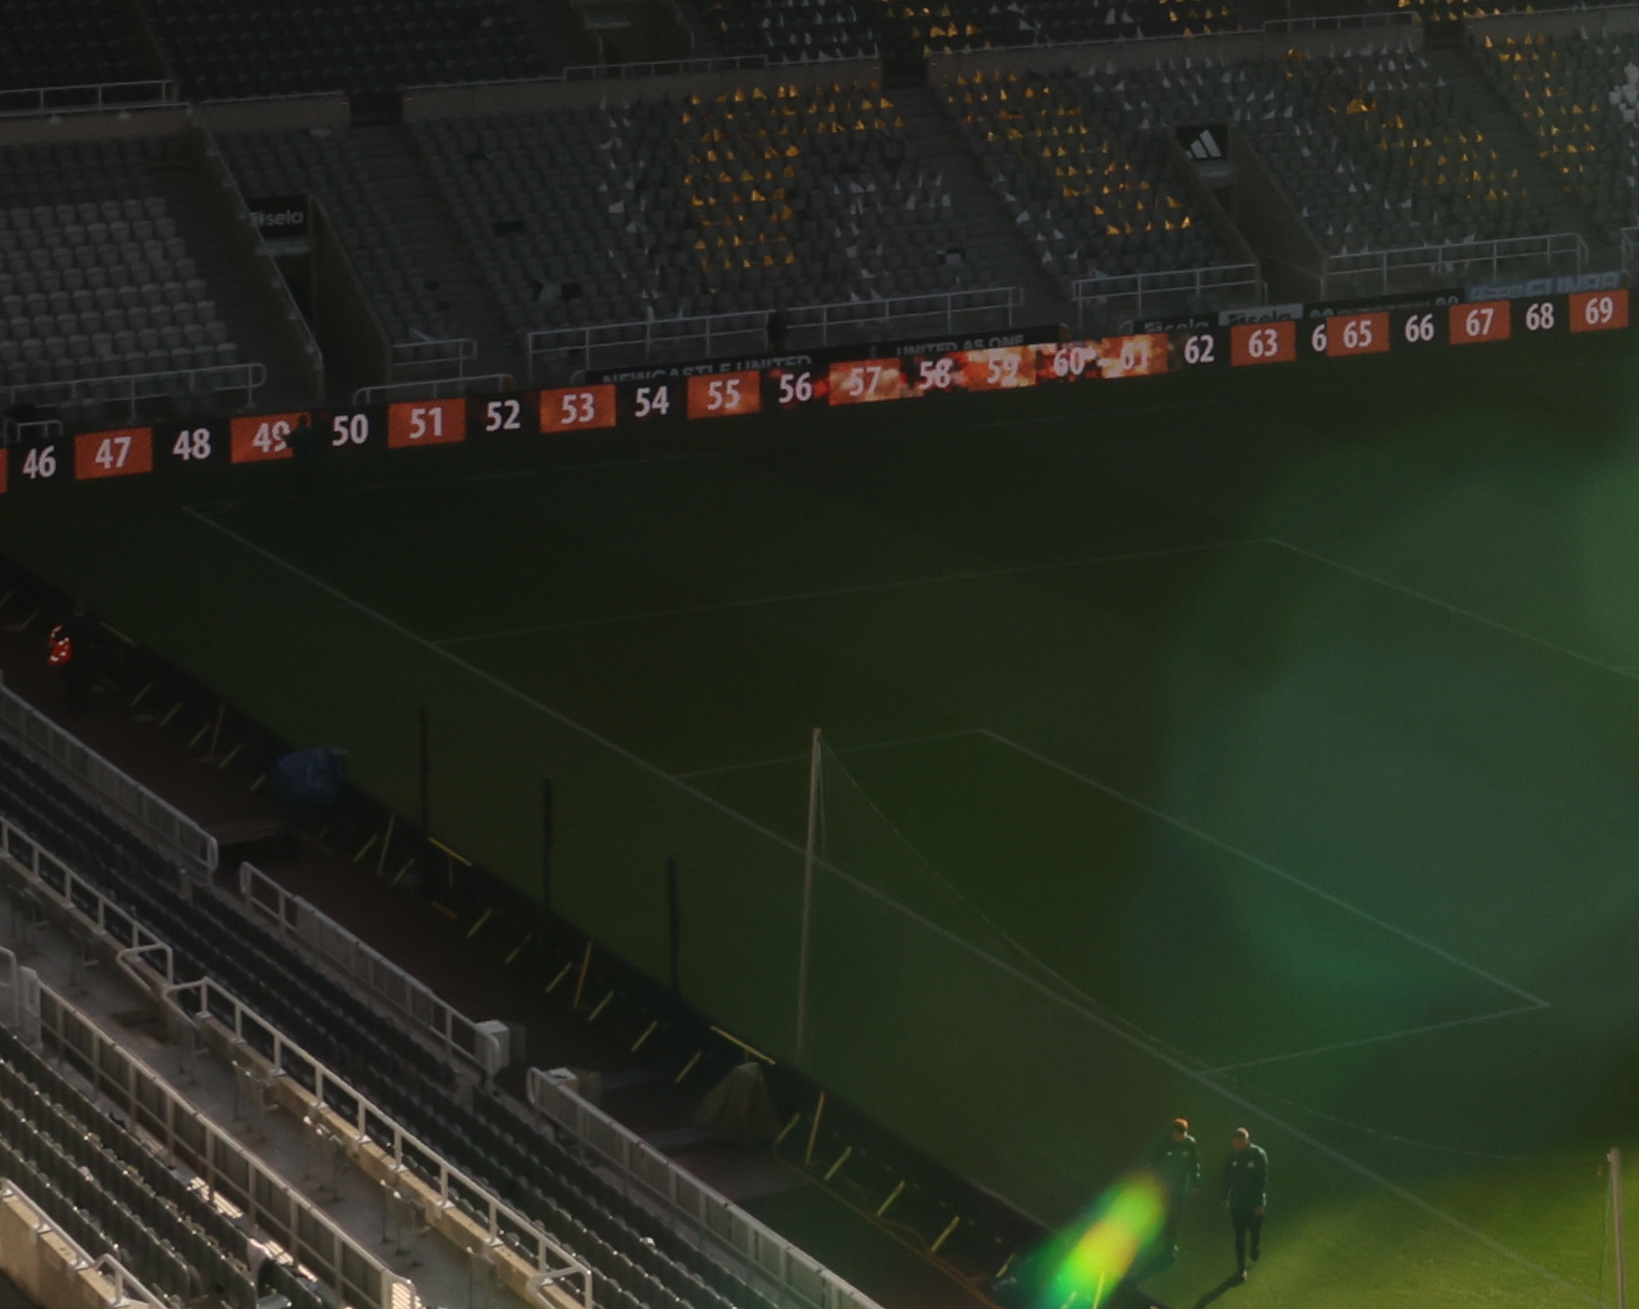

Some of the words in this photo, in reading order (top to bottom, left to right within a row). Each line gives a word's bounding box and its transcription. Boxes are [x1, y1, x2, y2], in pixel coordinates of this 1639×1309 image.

[265, 209, 303, 226] sela
[23, 446, 56, 478] 46
[95, 437, 131, 468] 47
[174, 428, 210, 460] 48
[253, 421, 290, 452] 49
[333, 414, 368, 446] 50
[410, 407, 441, 438] 51
[486, 400, 520, 431] 52
[562, 393, 594, 423] 53
[636, 386, 669, 417] 54
[708, 379, 740, 410] 55
[779, 372, 812, 403] 56
[849, 367, 881, 396] 57
[919, 359, 952, 389] 58
[987, 353, 1021, 386] 59
[1054, 347, 1085, 376] 60
[1185, 335, 1214, 363] 62
[1249, 329, 1277, 357] 63
[1344, 320, 1372, 348] 65
[1406, 314, 1434, 342] 66
[1466, 308, 1493, 336] 67
[1526, 303, 1554, 330] 68
[1586, 297, 1613, 324] 69
